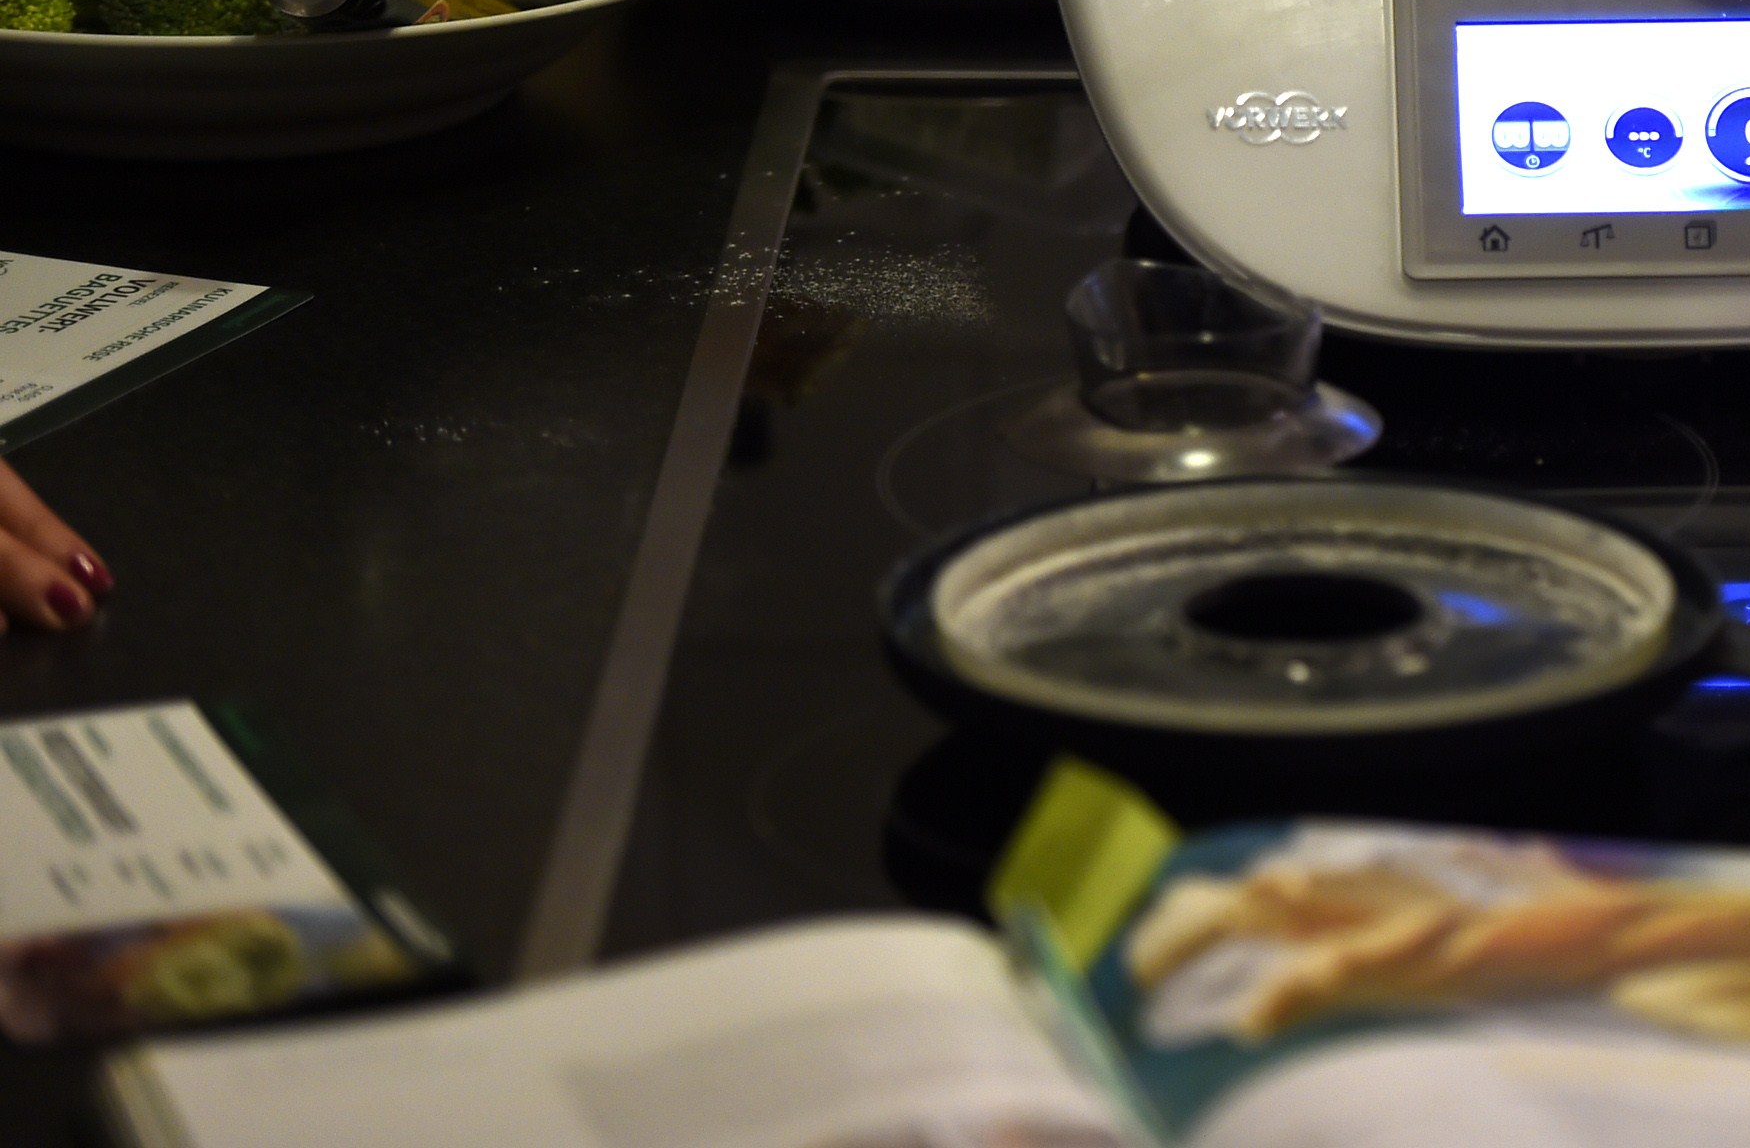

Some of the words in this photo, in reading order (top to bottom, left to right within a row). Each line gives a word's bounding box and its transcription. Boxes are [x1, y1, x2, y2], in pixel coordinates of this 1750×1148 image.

[1206, 105, 1350, 131] VORWERK
[0, 273, 123, 334] BAGUETTES
[38, 278, 157, 333] VOLLWERT-
[124, 287, 233, 341] KULINARISCHE
[82, 339, 133, 361] REISE
